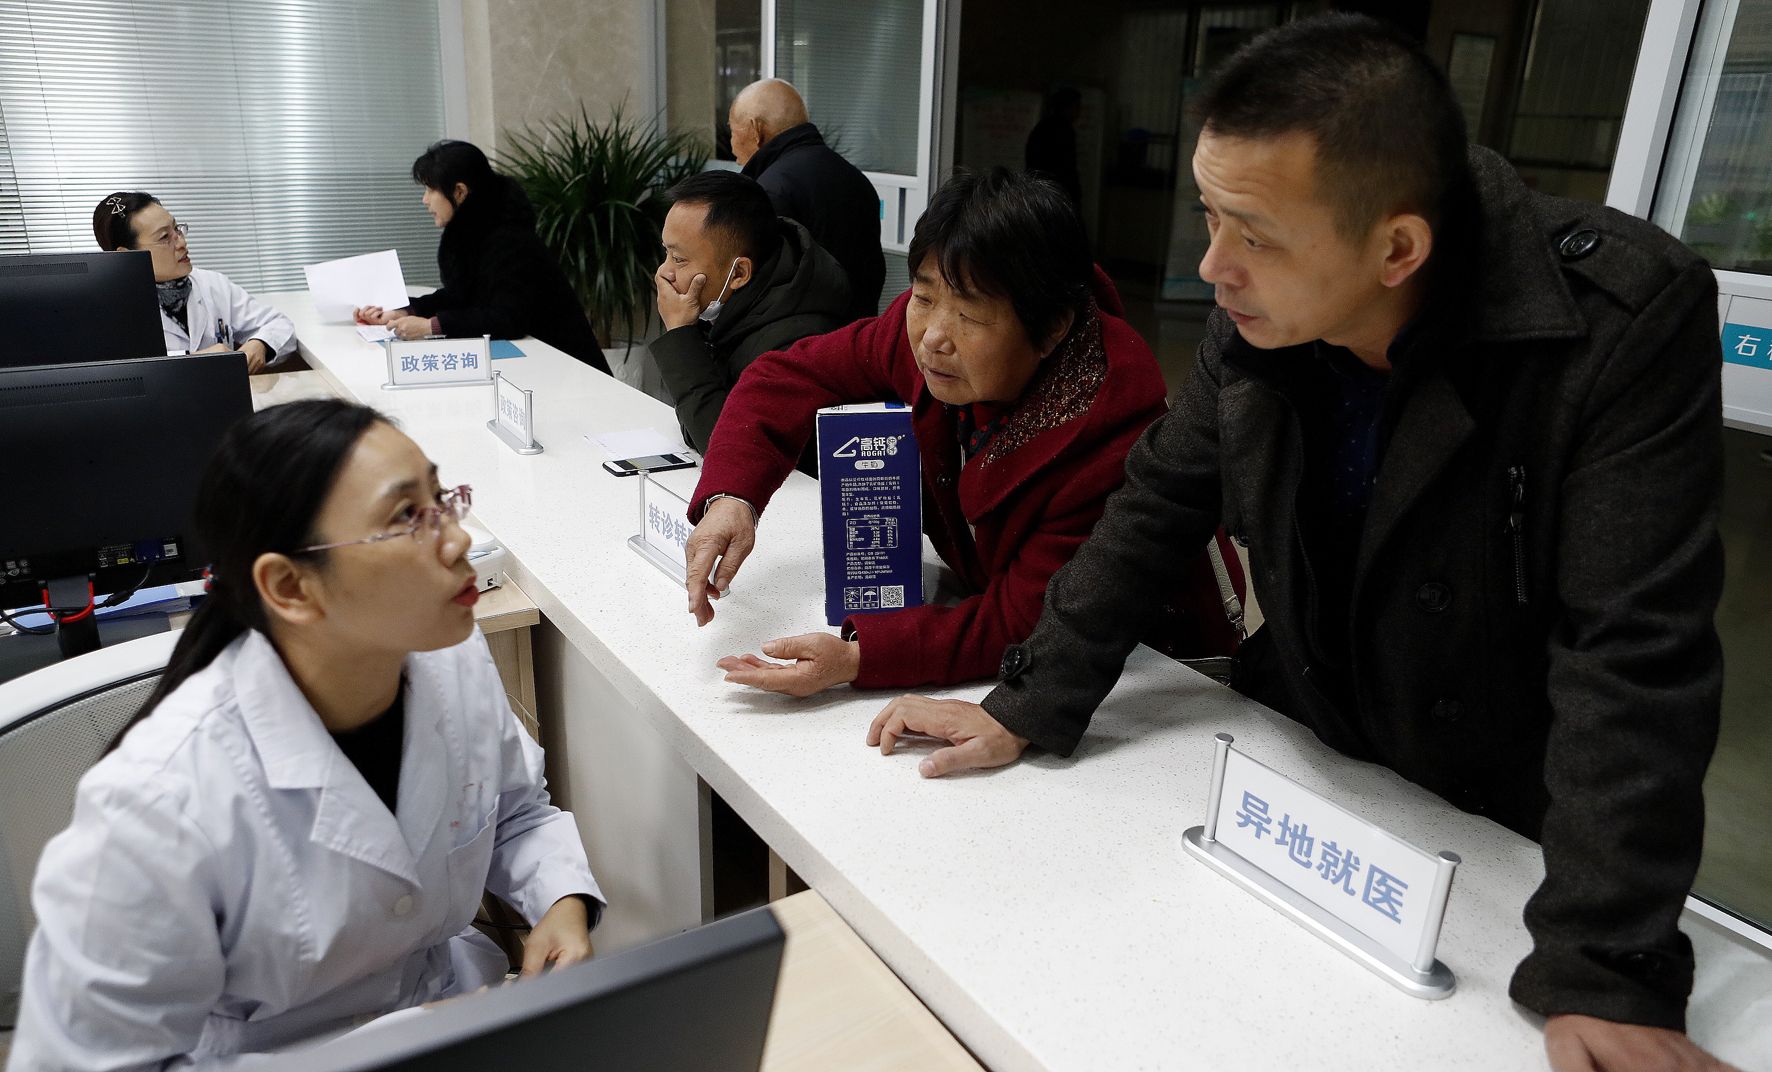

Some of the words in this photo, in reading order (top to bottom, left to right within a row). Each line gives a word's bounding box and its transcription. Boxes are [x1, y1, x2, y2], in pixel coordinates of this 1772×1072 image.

[401, 352, 478, 372] 政策咨询
[860, 437, 886, 451] 高钙
[648, 502, 693, 548] 转诊转
[1235, 790, 1409, 925] 异地就医
